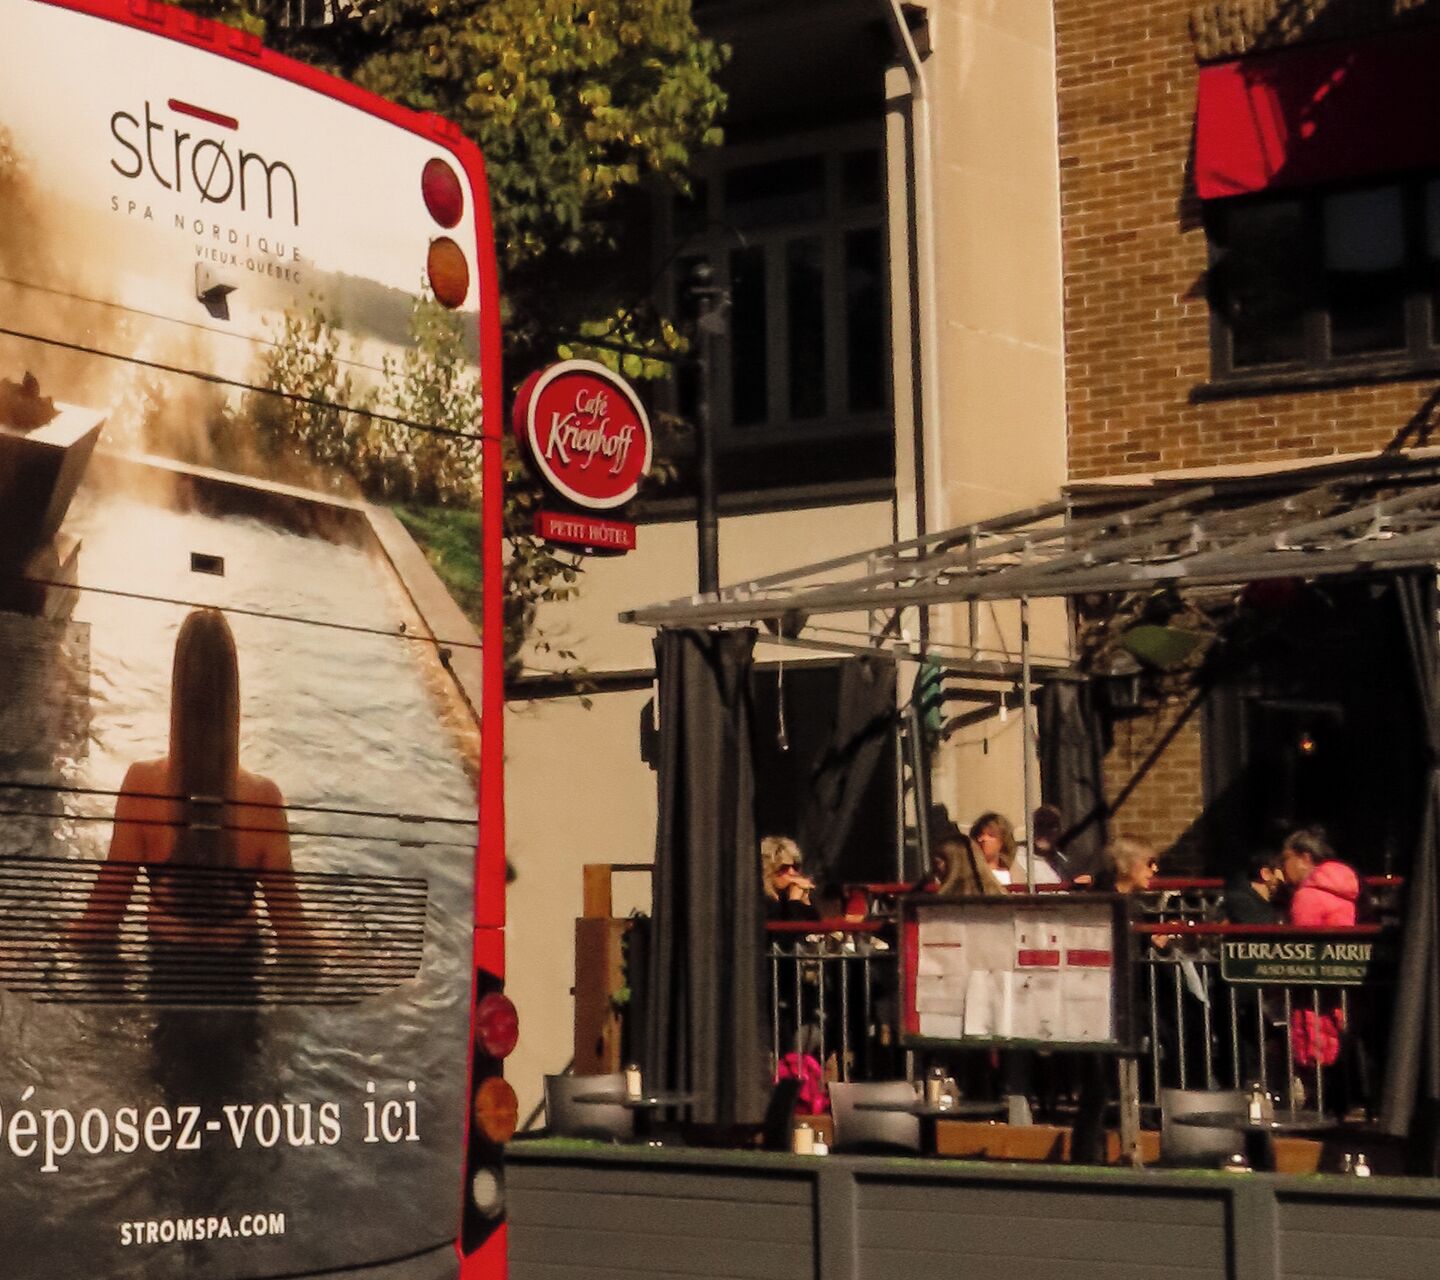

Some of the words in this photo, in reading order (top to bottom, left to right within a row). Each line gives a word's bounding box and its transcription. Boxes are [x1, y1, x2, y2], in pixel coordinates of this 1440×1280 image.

[110, 195, 155, 222] SPA
[174, 213, 302, 263] NORDIQUE
[575, 387, 609, 425] Café
[545, 410, 637, 476] Krieghoff
[550, 519, 585, 540] PETIT
[589, 522, 629, 546] HÔTEL
[1227, 942, 1316, 960] TERRASSE
[363, 1080, 421, 1143] ici
[120, 1212, 286, 1247] STROMSPA.COM
